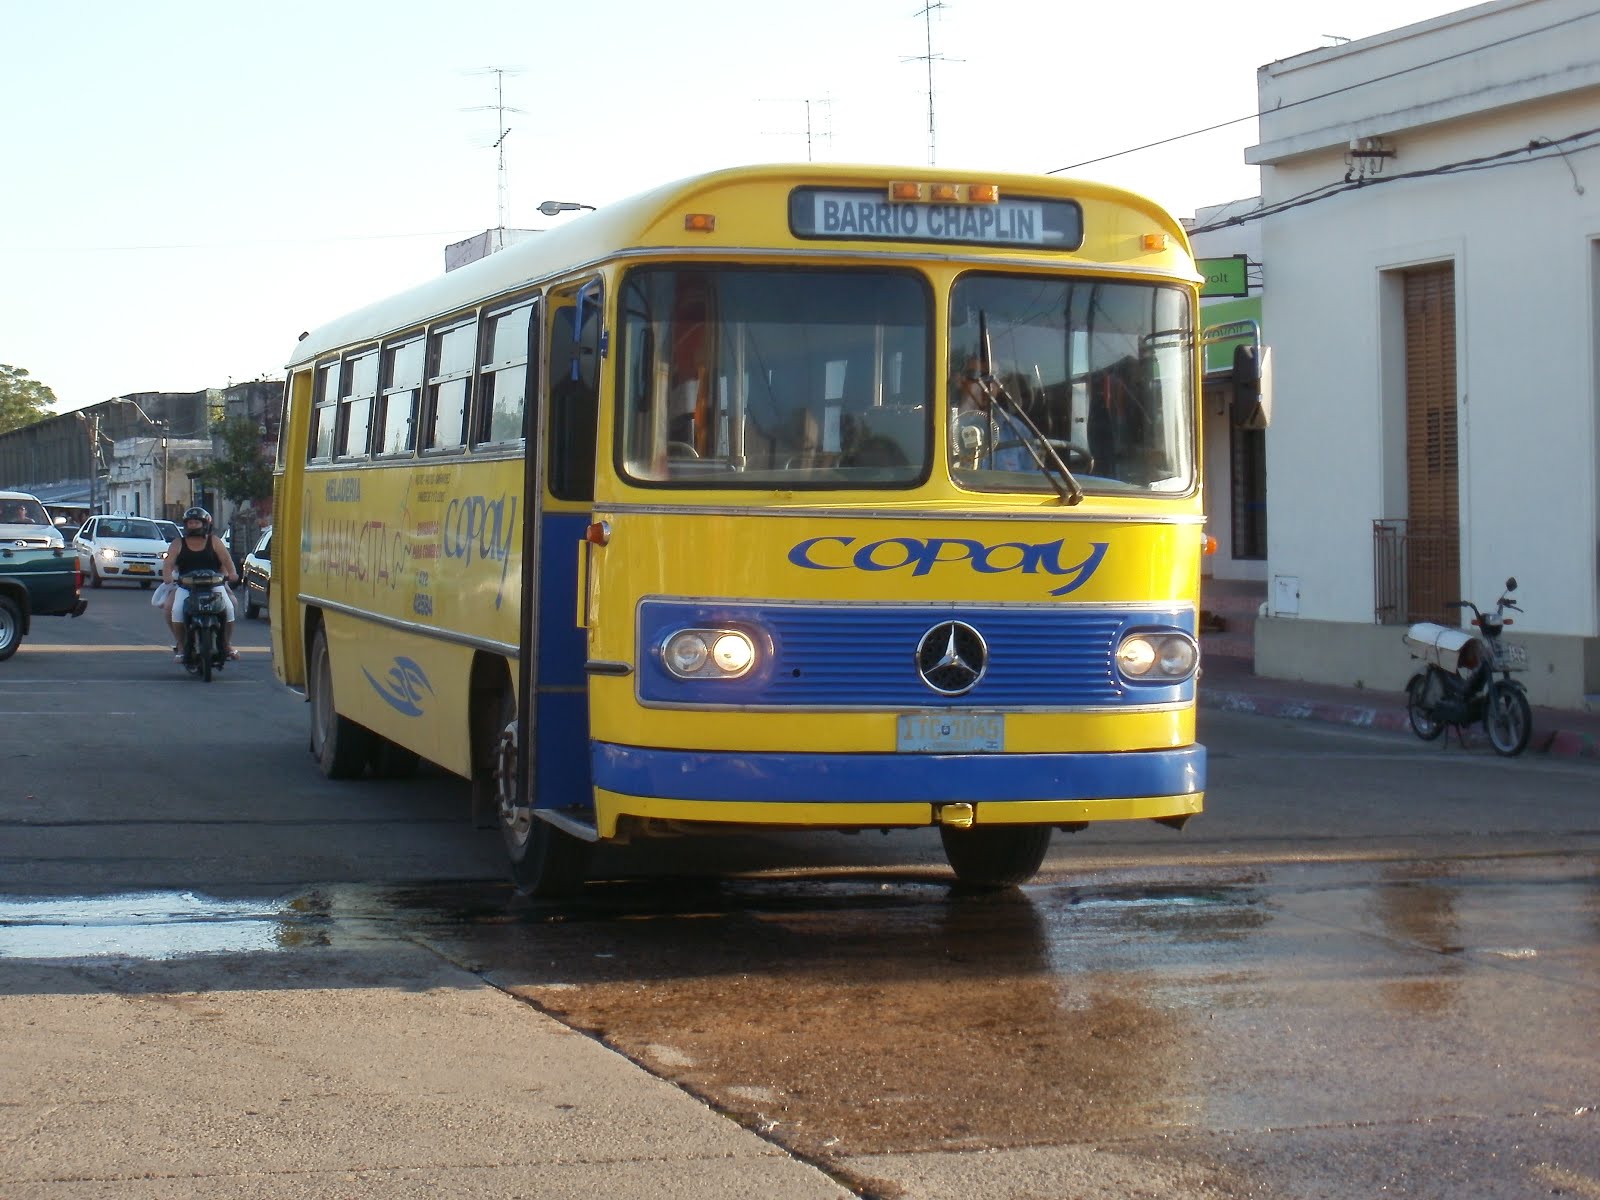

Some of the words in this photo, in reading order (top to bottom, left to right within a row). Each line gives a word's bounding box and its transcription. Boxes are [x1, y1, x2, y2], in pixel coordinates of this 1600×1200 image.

[823, 200, 918, 234] BARRIO
[926, 205, 1035, 240] CHAPLIN
[326, 476, 361, 502] HELADERIA
